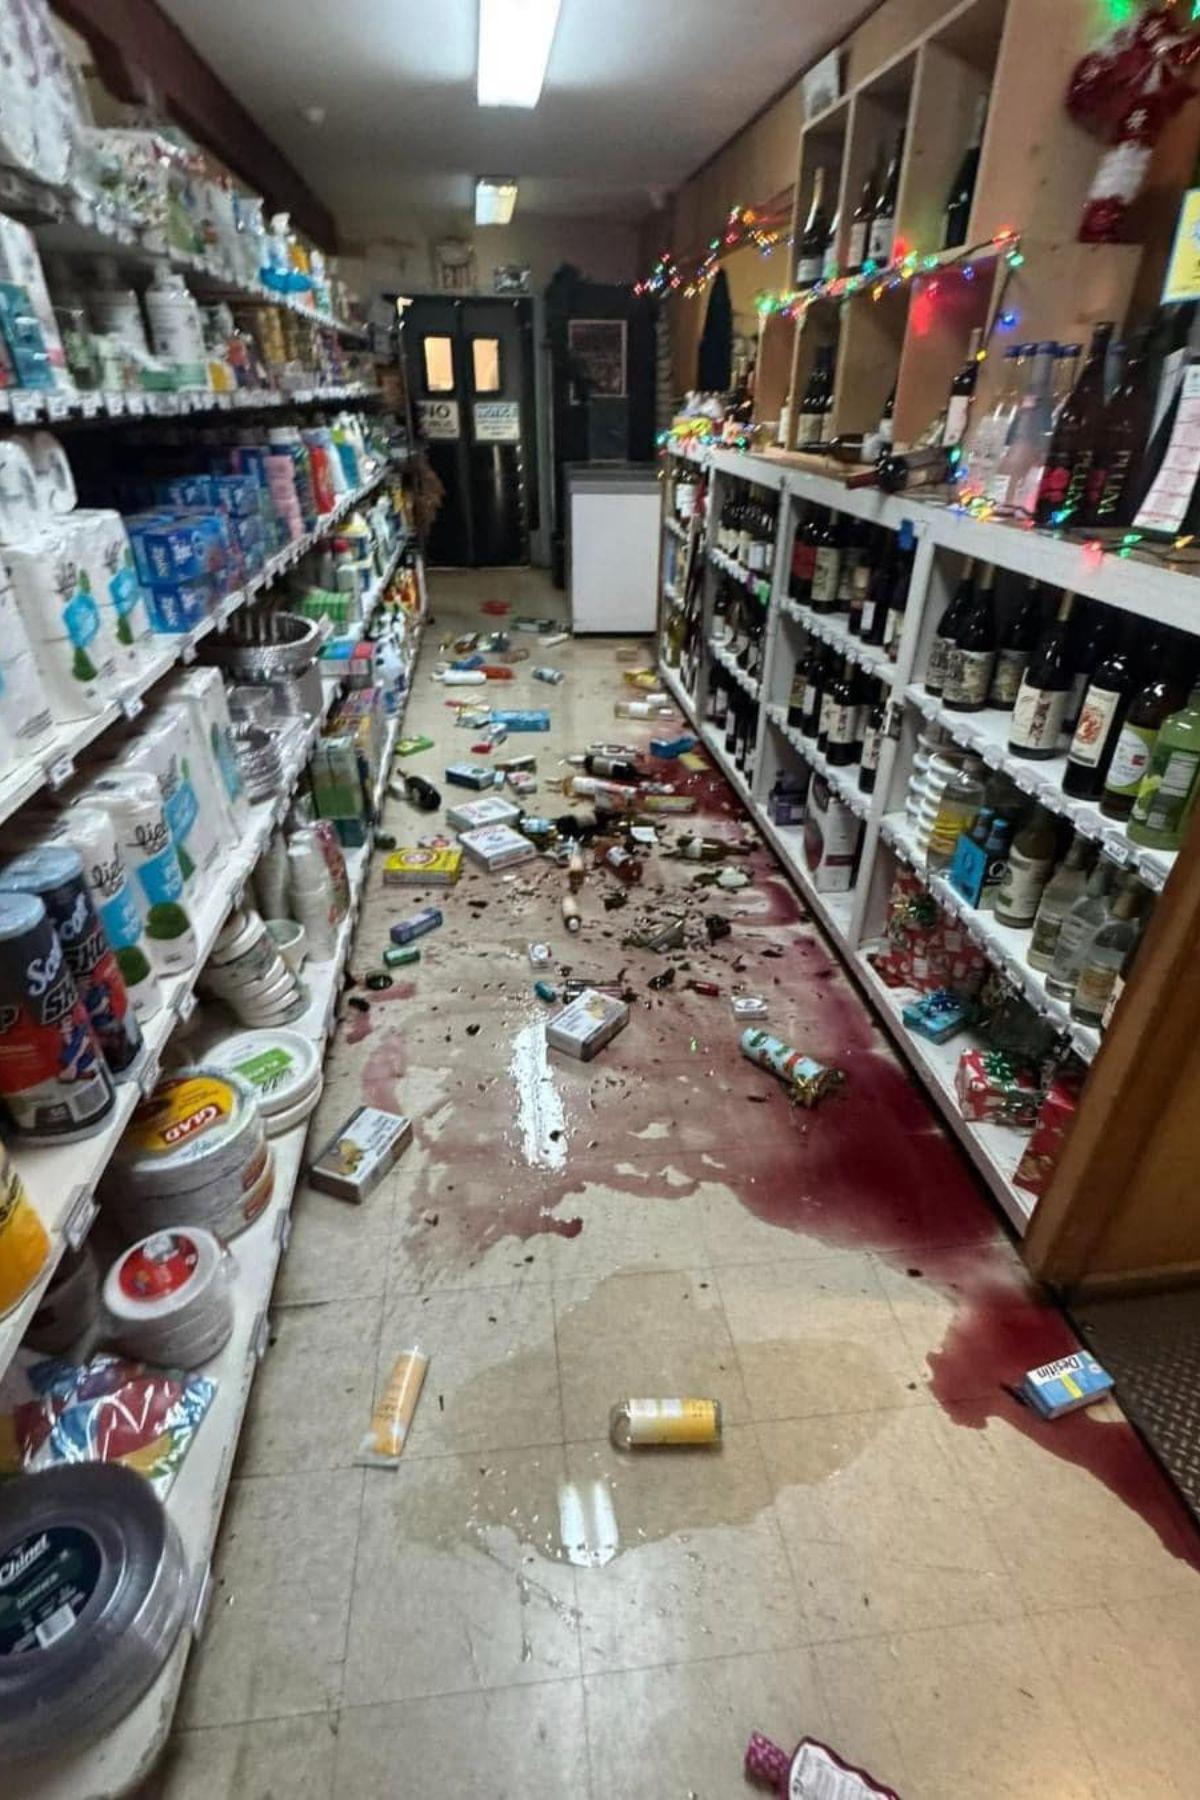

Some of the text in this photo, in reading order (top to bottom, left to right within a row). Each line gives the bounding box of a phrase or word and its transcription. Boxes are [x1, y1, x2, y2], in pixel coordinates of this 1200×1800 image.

[165, 1105, 217, 1141] GLAD
[1037, 1357, 1080, 1379] Desitin
[0, 1533, 49, 1587] Chinet
